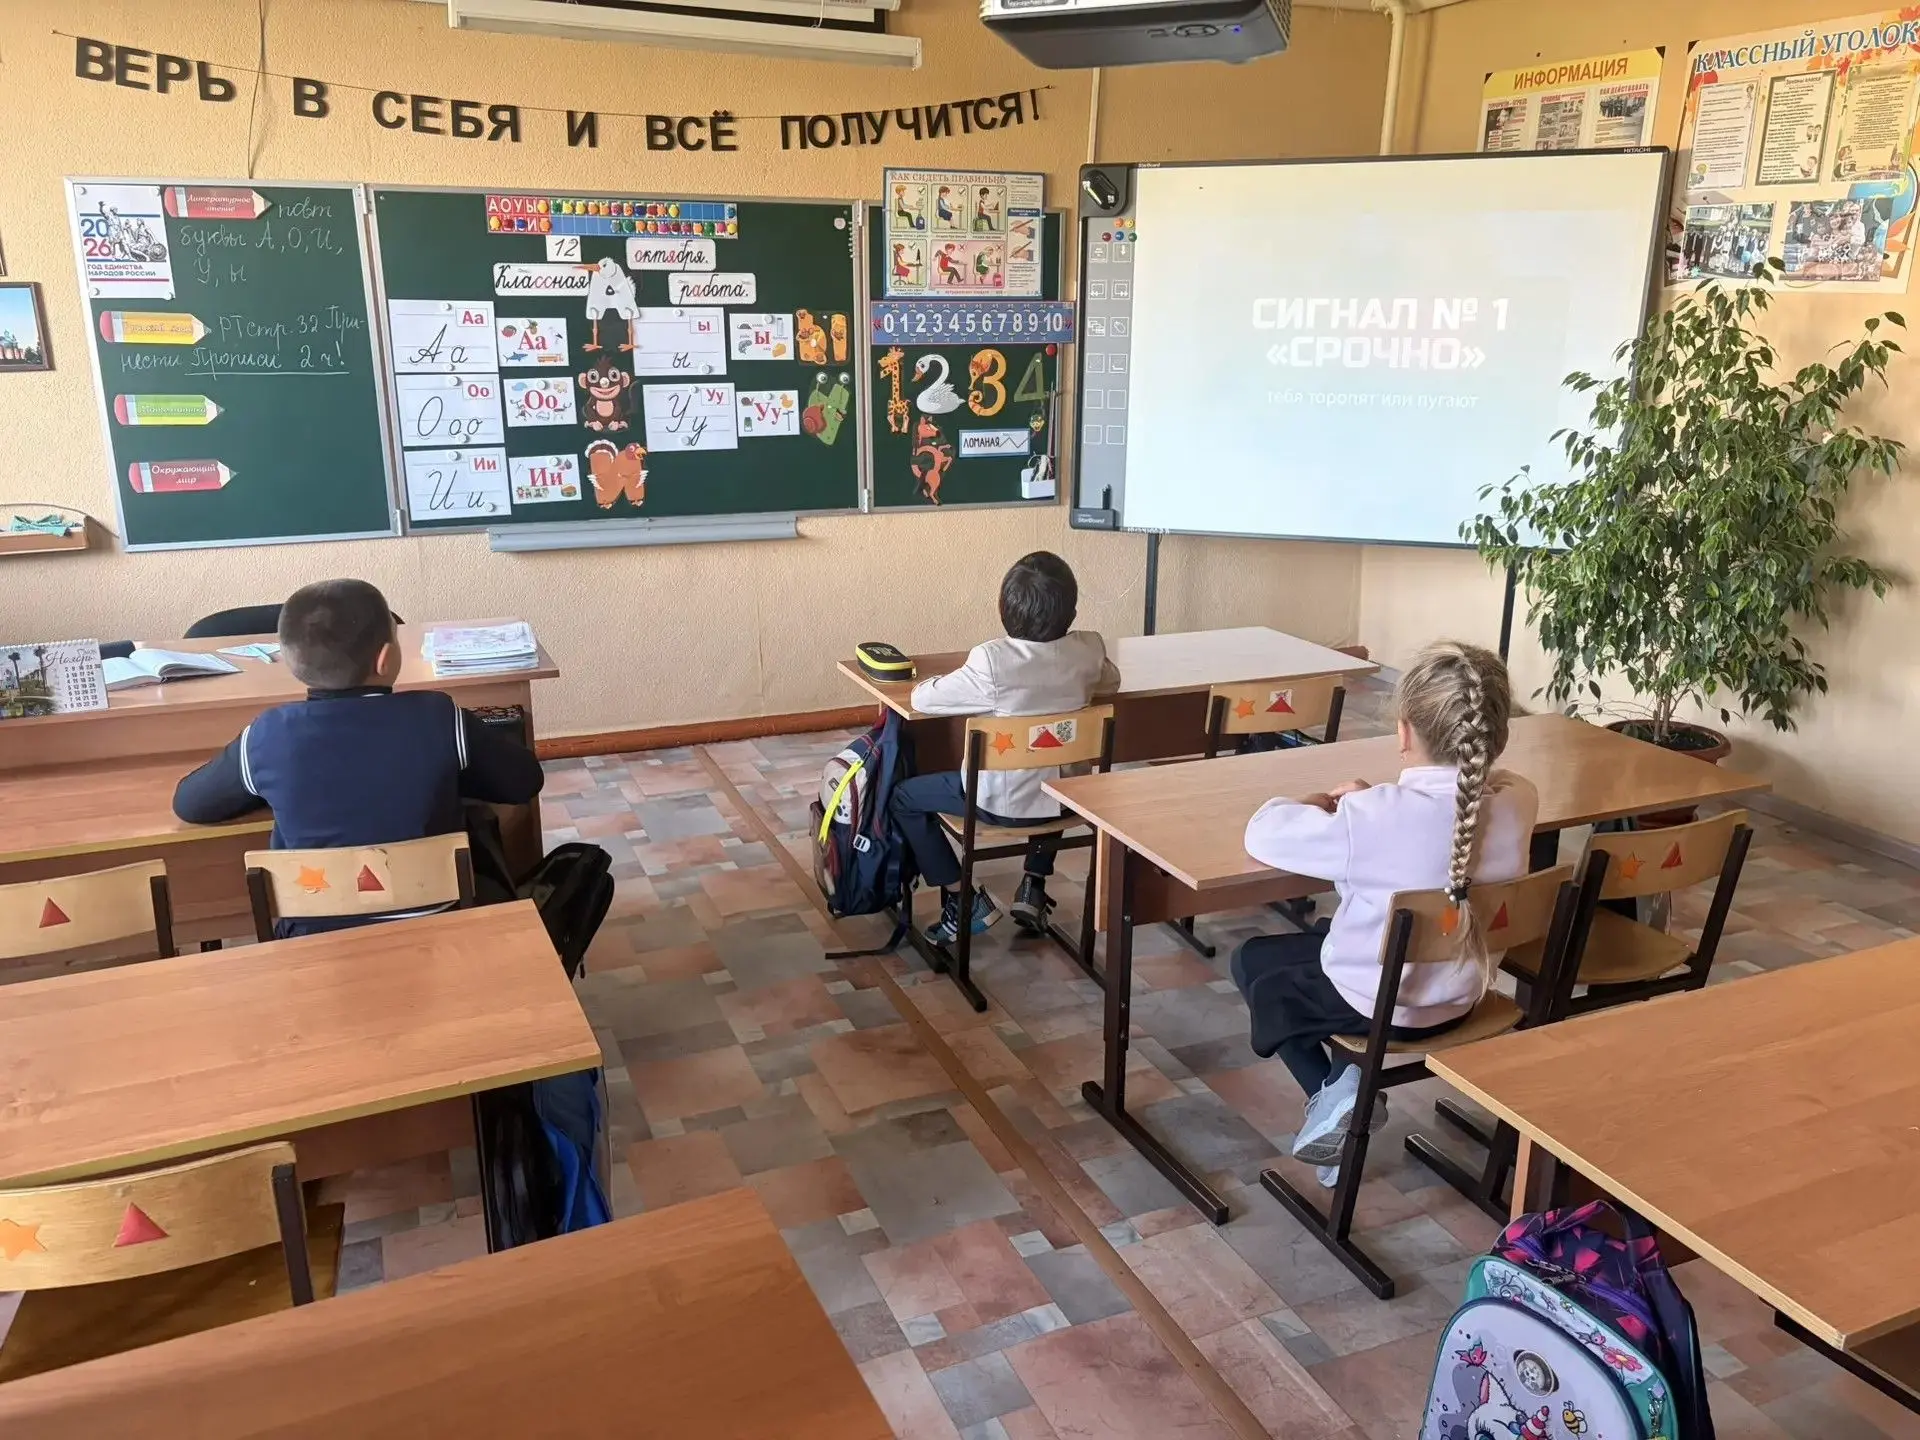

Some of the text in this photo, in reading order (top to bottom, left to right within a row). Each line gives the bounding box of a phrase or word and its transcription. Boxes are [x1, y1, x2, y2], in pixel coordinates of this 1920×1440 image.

[1695, 20, 1920, 73] КЛАССНЫЙ УГОЛОК
[1513, 57, 1628, 90] ИНФОРМАЦИЯ
[75, 37, 1040, 151] ВЕРЬ В СЕБЯ И ВСЁ ПОЛУЧИТСЯ!
[890, 173, 1007, 185] КАК СИДЕТЬ ПРАВИЛЬНО
[80, 218, 110, 237] 20
[83, 238, 112, 256] 26
[555, 238, 710, 271] 12 октября.
[495, 263, 750, 305] Классная работа.
[299, 314, 319, 335] 32
[462, 310, 485, 325] Аа
[884, 312, 1063, 333] 0 1 2 3 4 5 6 7 8 9 10
[1252, 297, 1511, 331] СИГНАЛ № 1
[518, 330, 548, 351] Аа
[755, 331, 771, 345] Ы
[121, 351, 184, 373] нести
[190, 347, 283, 380] Прописи
[300, 344, 315, 369] 2
[1265, 336, 1487, 370] «СРОЧНО»
[467, 384, 490, 398] Оо
[524, 390, 559, 410] Оо
[706, 388, 724, 404] Уу
[1268, 390, 1479, 411] тебя торопят или пугают
[754, 402, 782, 425] Уу
[963, 436, 1000, 449] ЛОМАНАЯ
[151, 463, 216, 476] Окружающий
[473, 458, 497, 471] Ии
[529, 467, 564, 487] Ии
